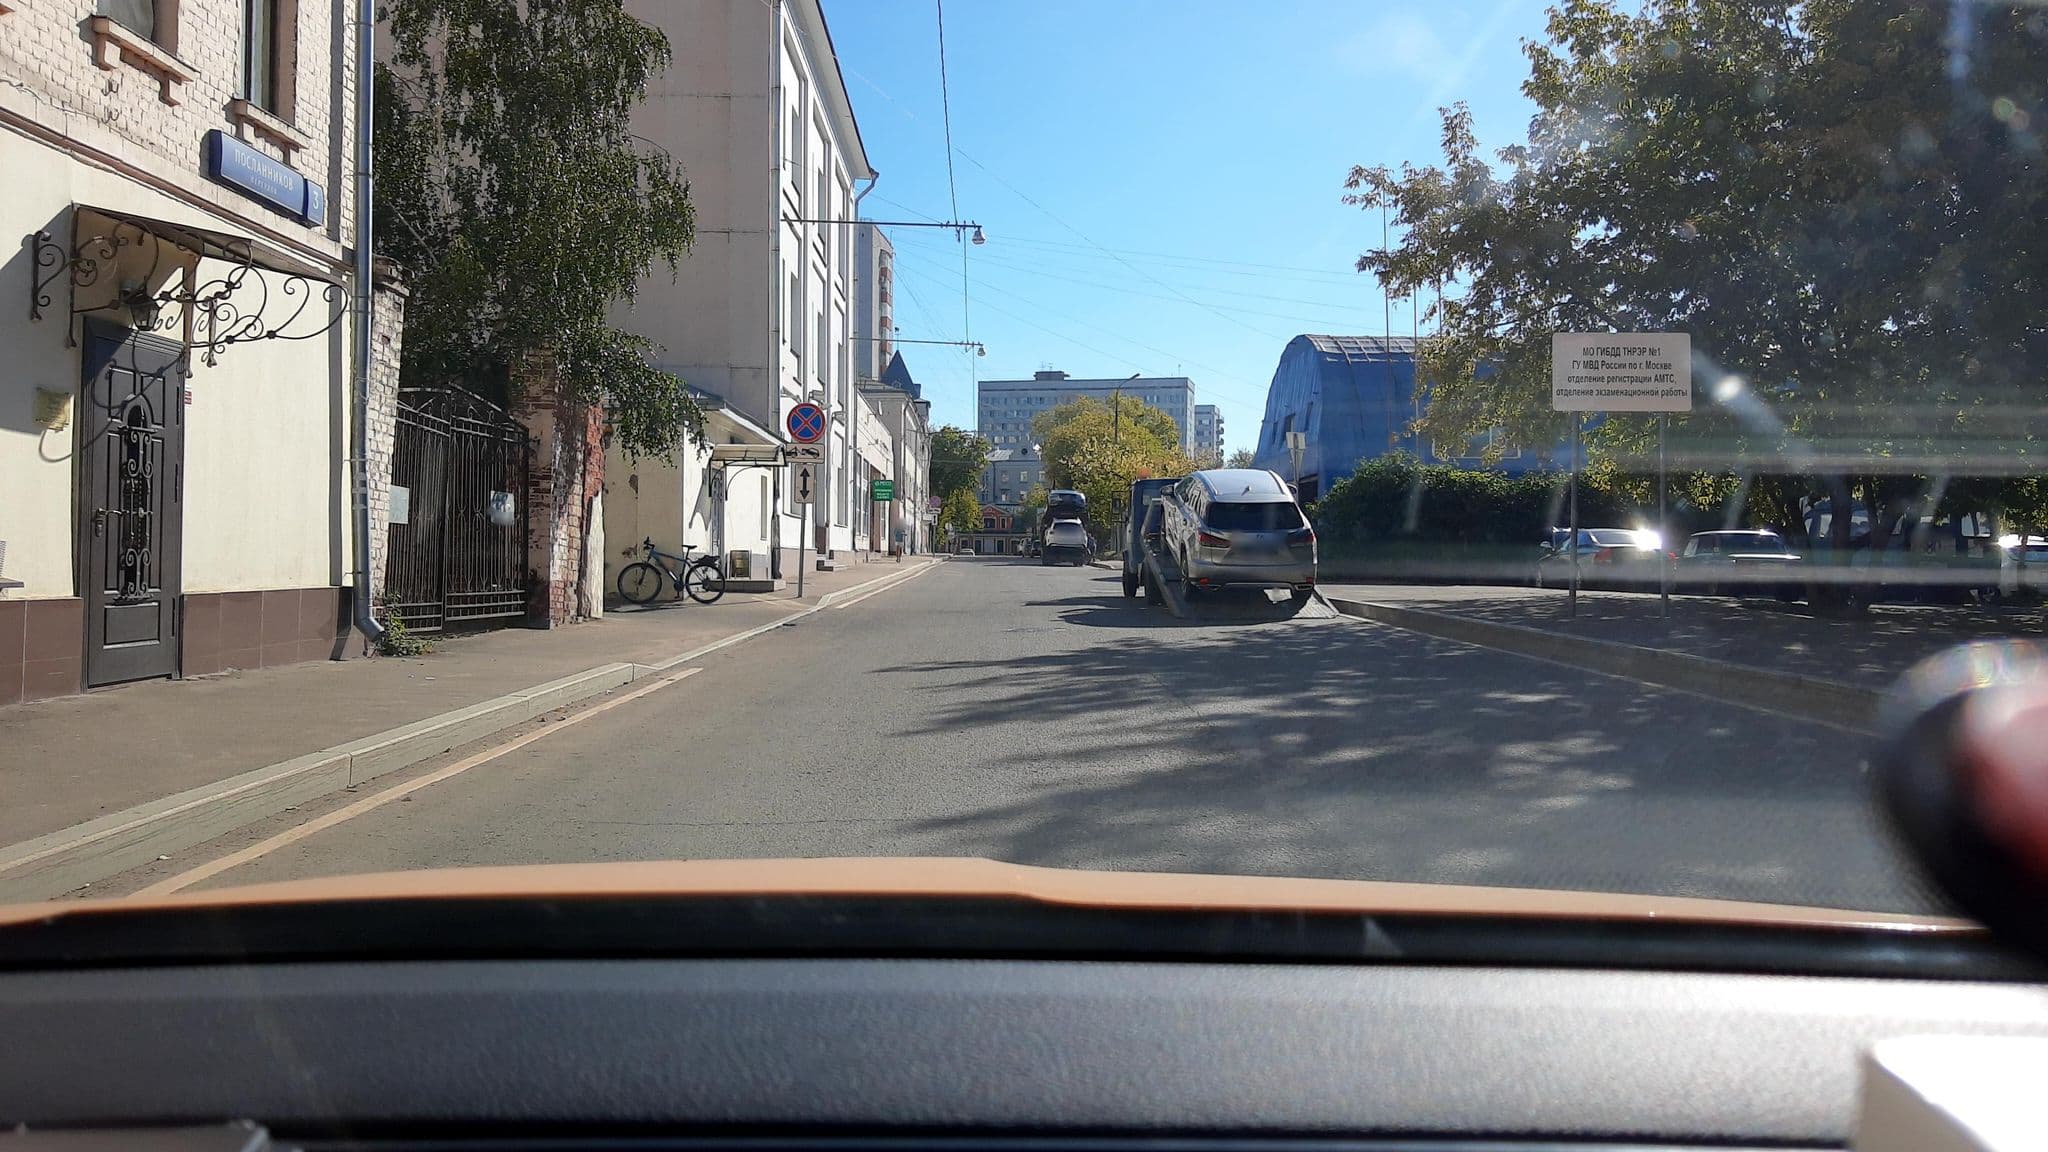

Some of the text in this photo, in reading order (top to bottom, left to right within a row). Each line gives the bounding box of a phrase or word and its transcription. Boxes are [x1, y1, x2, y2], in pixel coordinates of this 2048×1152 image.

[234, 149, 293, 192] ПОСЛАННИКОВ
[312, 191, 319, 210] 3
[1582, 347, 1661, 358] МО ГИБДД ТНРЭР №1
[1572, 360, 1672, 371] ГУ МВД России по г. Москве
[1567, 375, 1607, 385] отделение
[1607, 375, 1652, 385] регистрации
[1556, 387, 1688, 398] отделение экзаменационной работы
